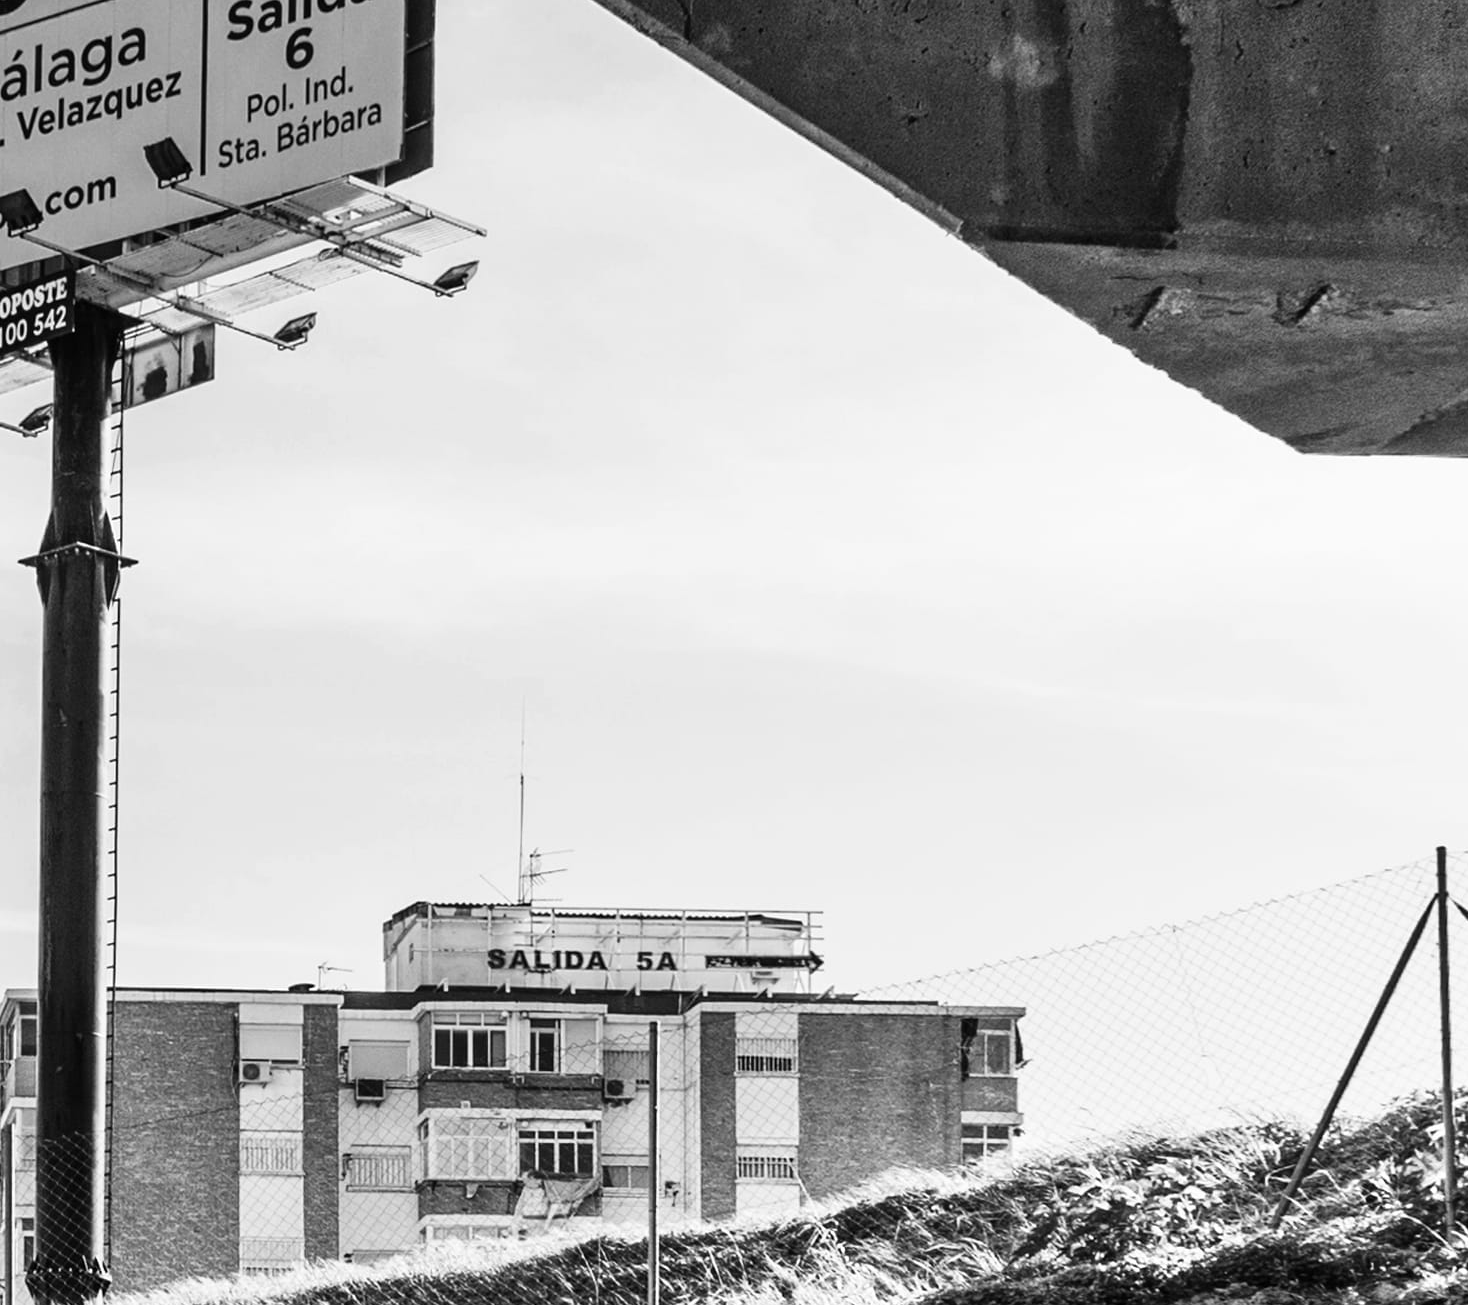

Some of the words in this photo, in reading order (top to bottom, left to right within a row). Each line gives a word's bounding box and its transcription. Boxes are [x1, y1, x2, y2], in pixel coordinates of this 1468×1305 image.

[285, 26, 314, 70] 6
[16, 70, 183, 140] Velazquez
[247, 83, 294, 123] Pol.
[305, 65, 354, 105] Ind.
[218, 137, 267, 168] Sta.
[277, 102, 382, 153] Bárbara
[32, 305, 67, 336] 542
[487, 948, 608, 970] SALIDA
[636, 951, 679, 971] 5A
